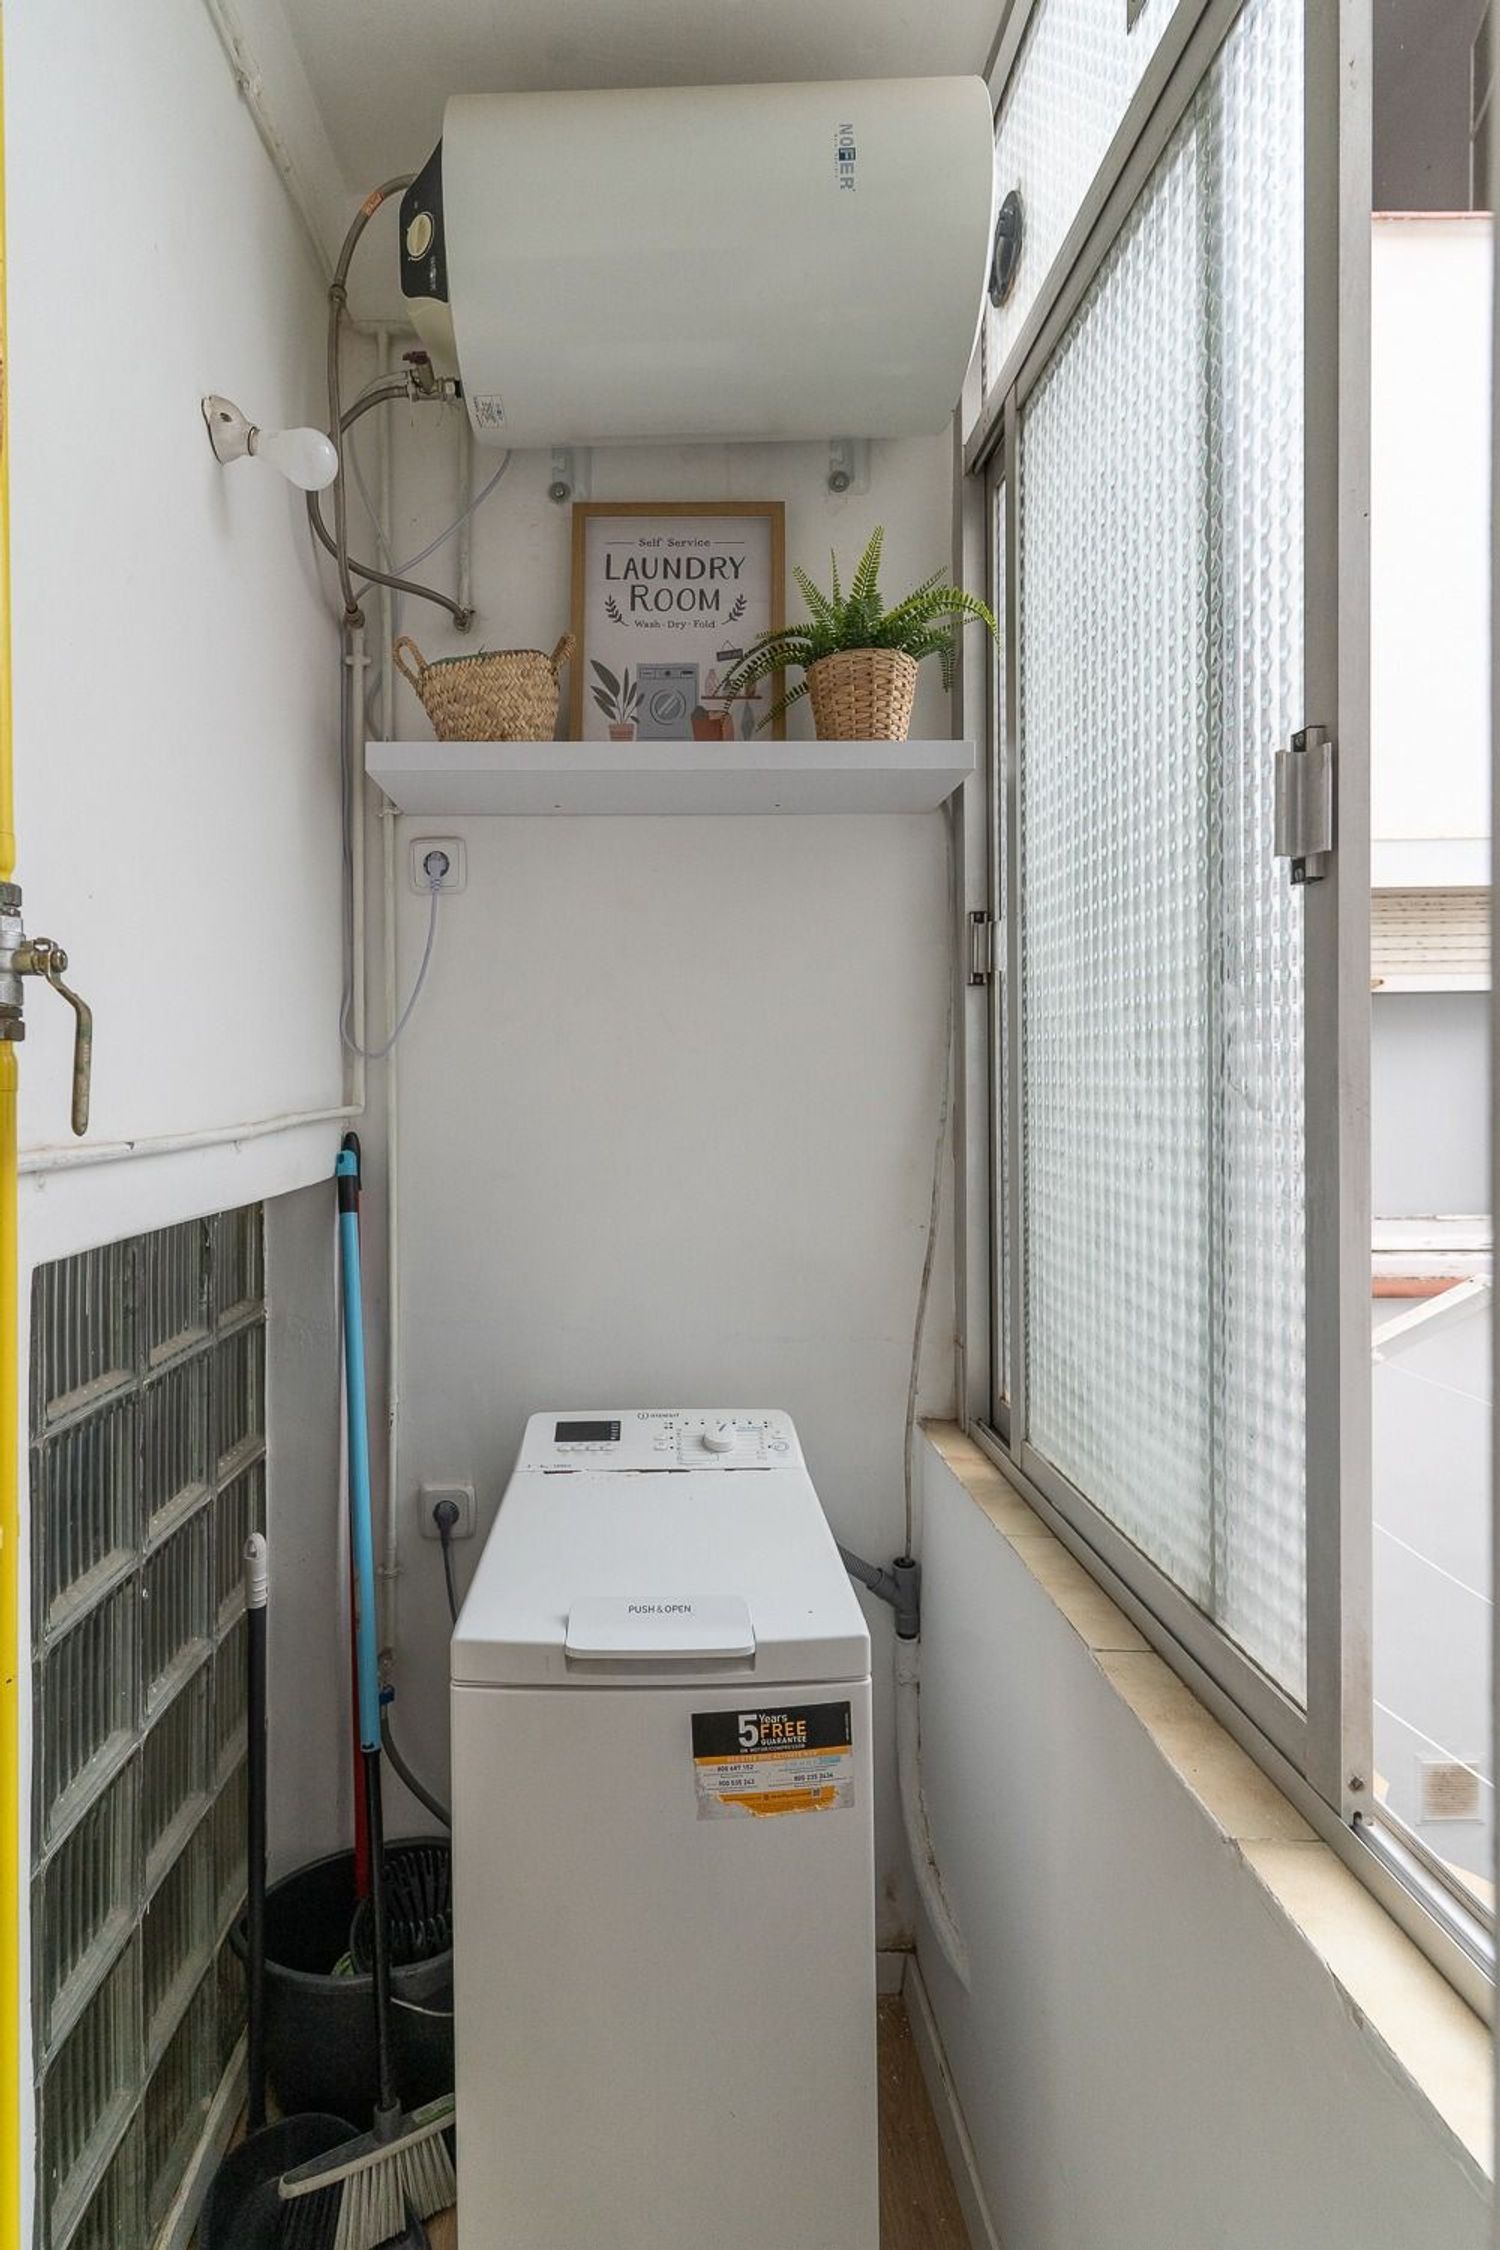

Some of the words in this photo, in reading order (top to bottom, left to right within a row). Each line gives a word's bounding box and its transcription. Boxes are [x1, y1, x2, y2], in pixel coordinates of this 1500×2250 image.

[839, 124, 856, 190] NOFER
[638, 537, 661, 548] Self
[667, 537, 711, 548] Service
[605, 553, 746, 581] LAUNDRY
[630, 584, 721, 612] ROOM
[634, 619, 661, 629] Wash
[667, 619, 687, 631] Dry
[693, 619, 716, 629] Fold
[759, 1713, 788, 1724] Years
[760, 1720, 807, 1739] FREE
[738, 1714, 759, 1748] 5
